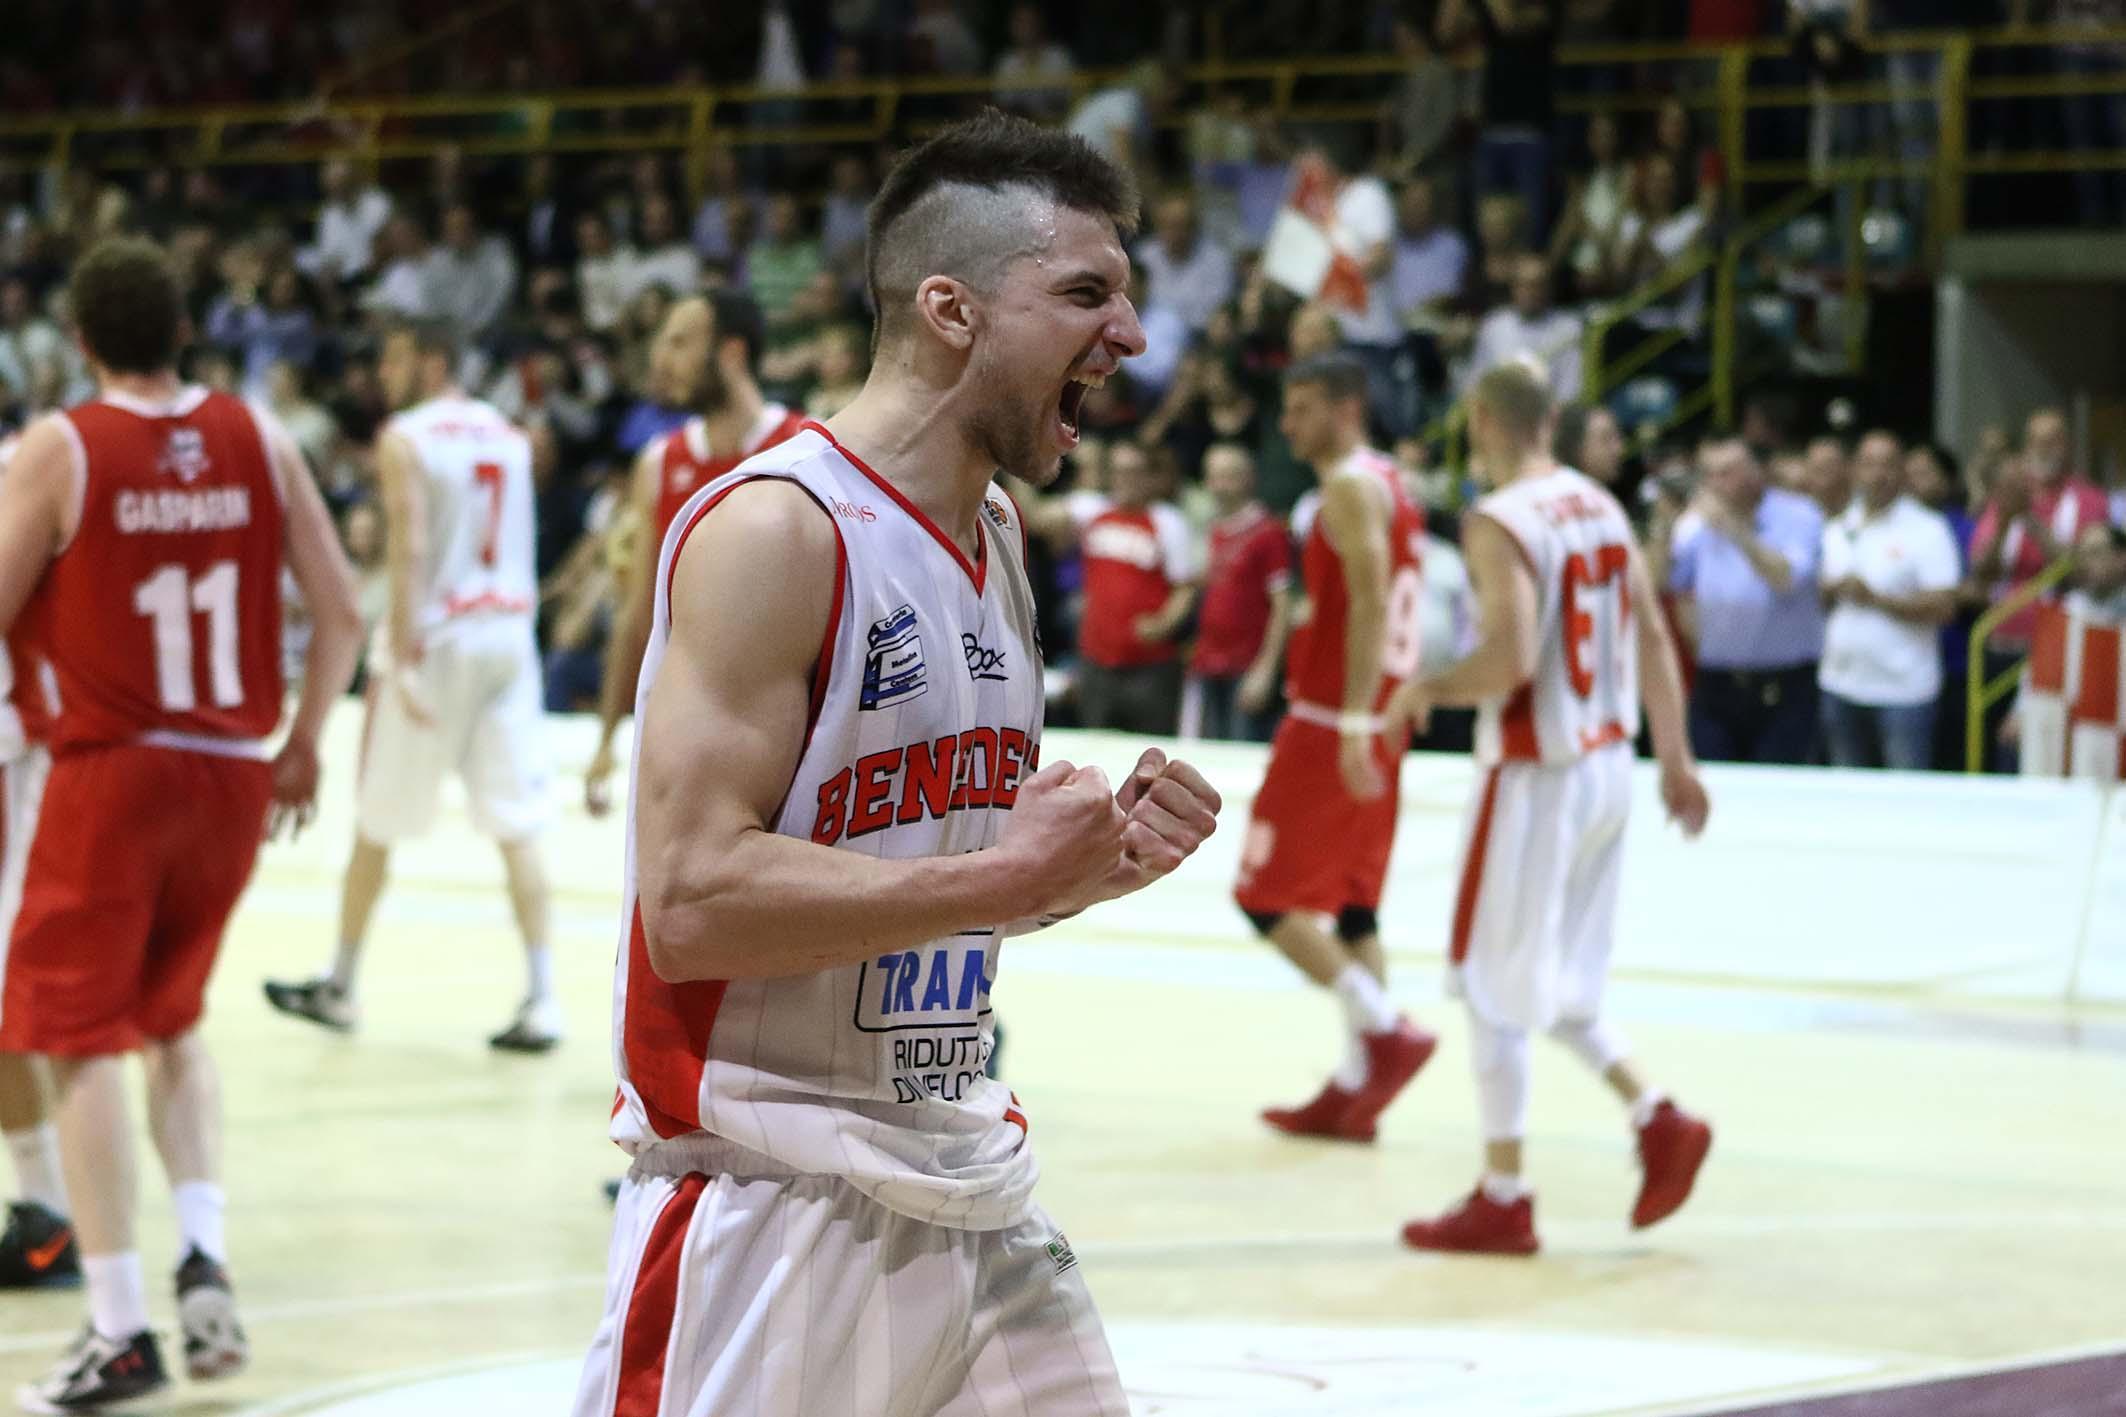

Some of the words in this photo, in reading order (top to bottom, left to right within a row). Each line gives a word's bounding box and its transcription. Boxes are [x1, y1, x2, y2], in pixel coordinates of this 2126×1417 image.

[472, 463, 508, 568] 7
[134, 560, 245, 711] 11
[960, 633, 1008, 681] Box
